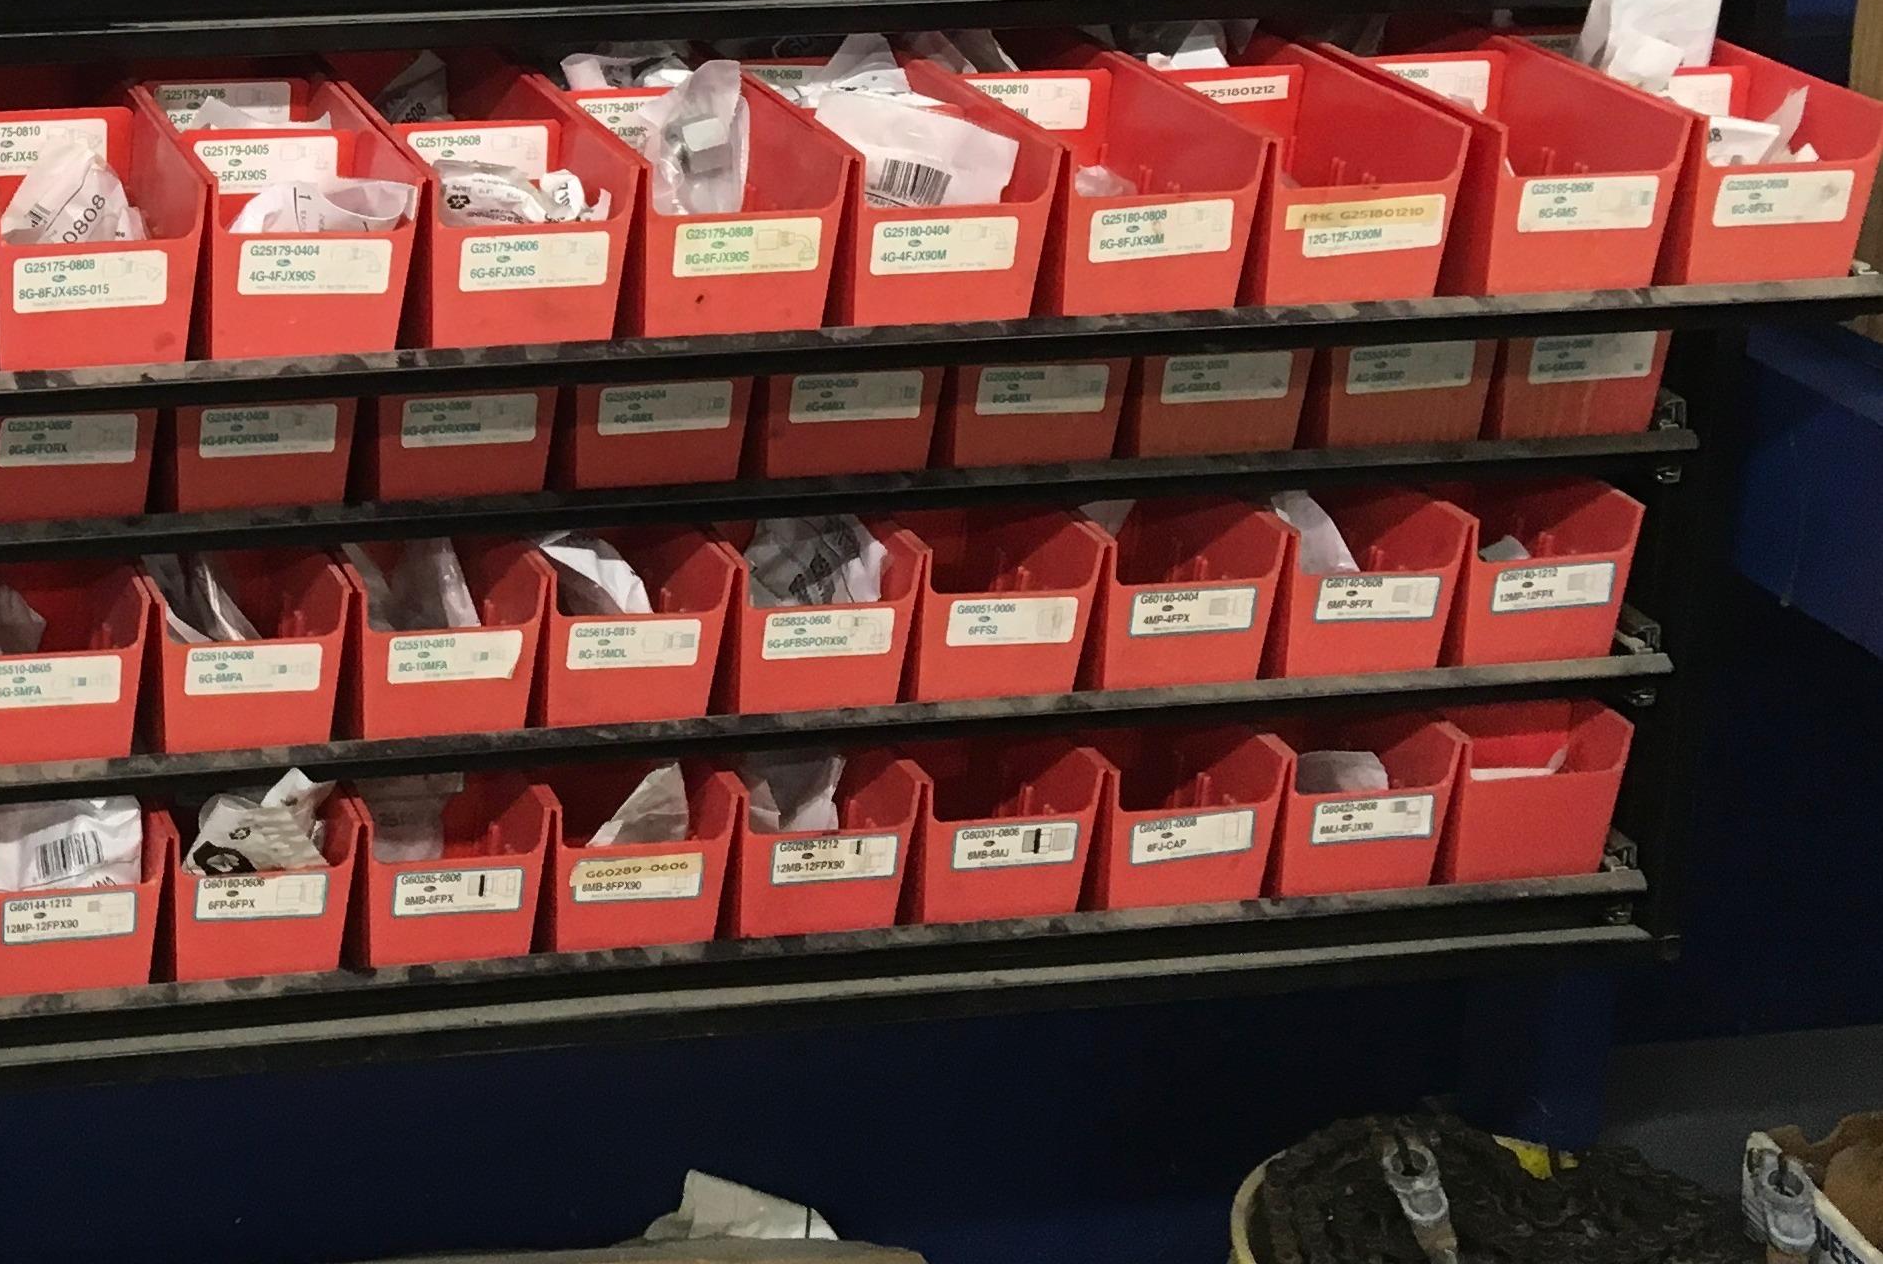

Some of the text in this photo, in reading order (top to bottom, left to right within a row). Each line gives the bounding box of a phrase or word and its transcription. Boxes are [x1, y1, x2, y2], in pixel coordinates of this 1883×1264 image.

[416, 135, 481, 149] G25179-0608
[202, 143, 270, 157] G25179-0405
[63, 195, 105, 243] 0808
[1101, 209, 1167, 225] G25180-0808
[686, 225, 753, 240] G25179-0808
[883, 224, 950, 239] G25180-0404
[1307, 228, 1382, 245] 12G-12FJX90M
[470, 239, 539, 253] G25179-0606
[1099, 233, 1165, 249] 8G-8FJX90M
[250, 245, 319, 259] G25179-0404
[685, 250, 749, 265] 8G-8FJX90S
[880, 248, 947, 263] 4G-4FJX90M
[24, 259, 95, 275] G25175-0808
[470, 265, 535, 280] 6G-6FJX90S
[249, 269, 316, 283] 4G-4FJX90S
[18, 283, 109, 299] 8G-8FJX45S-015
[1143, 613, 1191, 626] 4MP-4FPX
[968, 625, 997, 636] 6FFS2
[775, 859, 845, 873] 12MB-12FPX90
[9, 898, 72, 913] G60144-1212
[208, 898, 255, 910] 6FP-6FPX
[5, 918, 78, 934] 12MP-12FPX90
